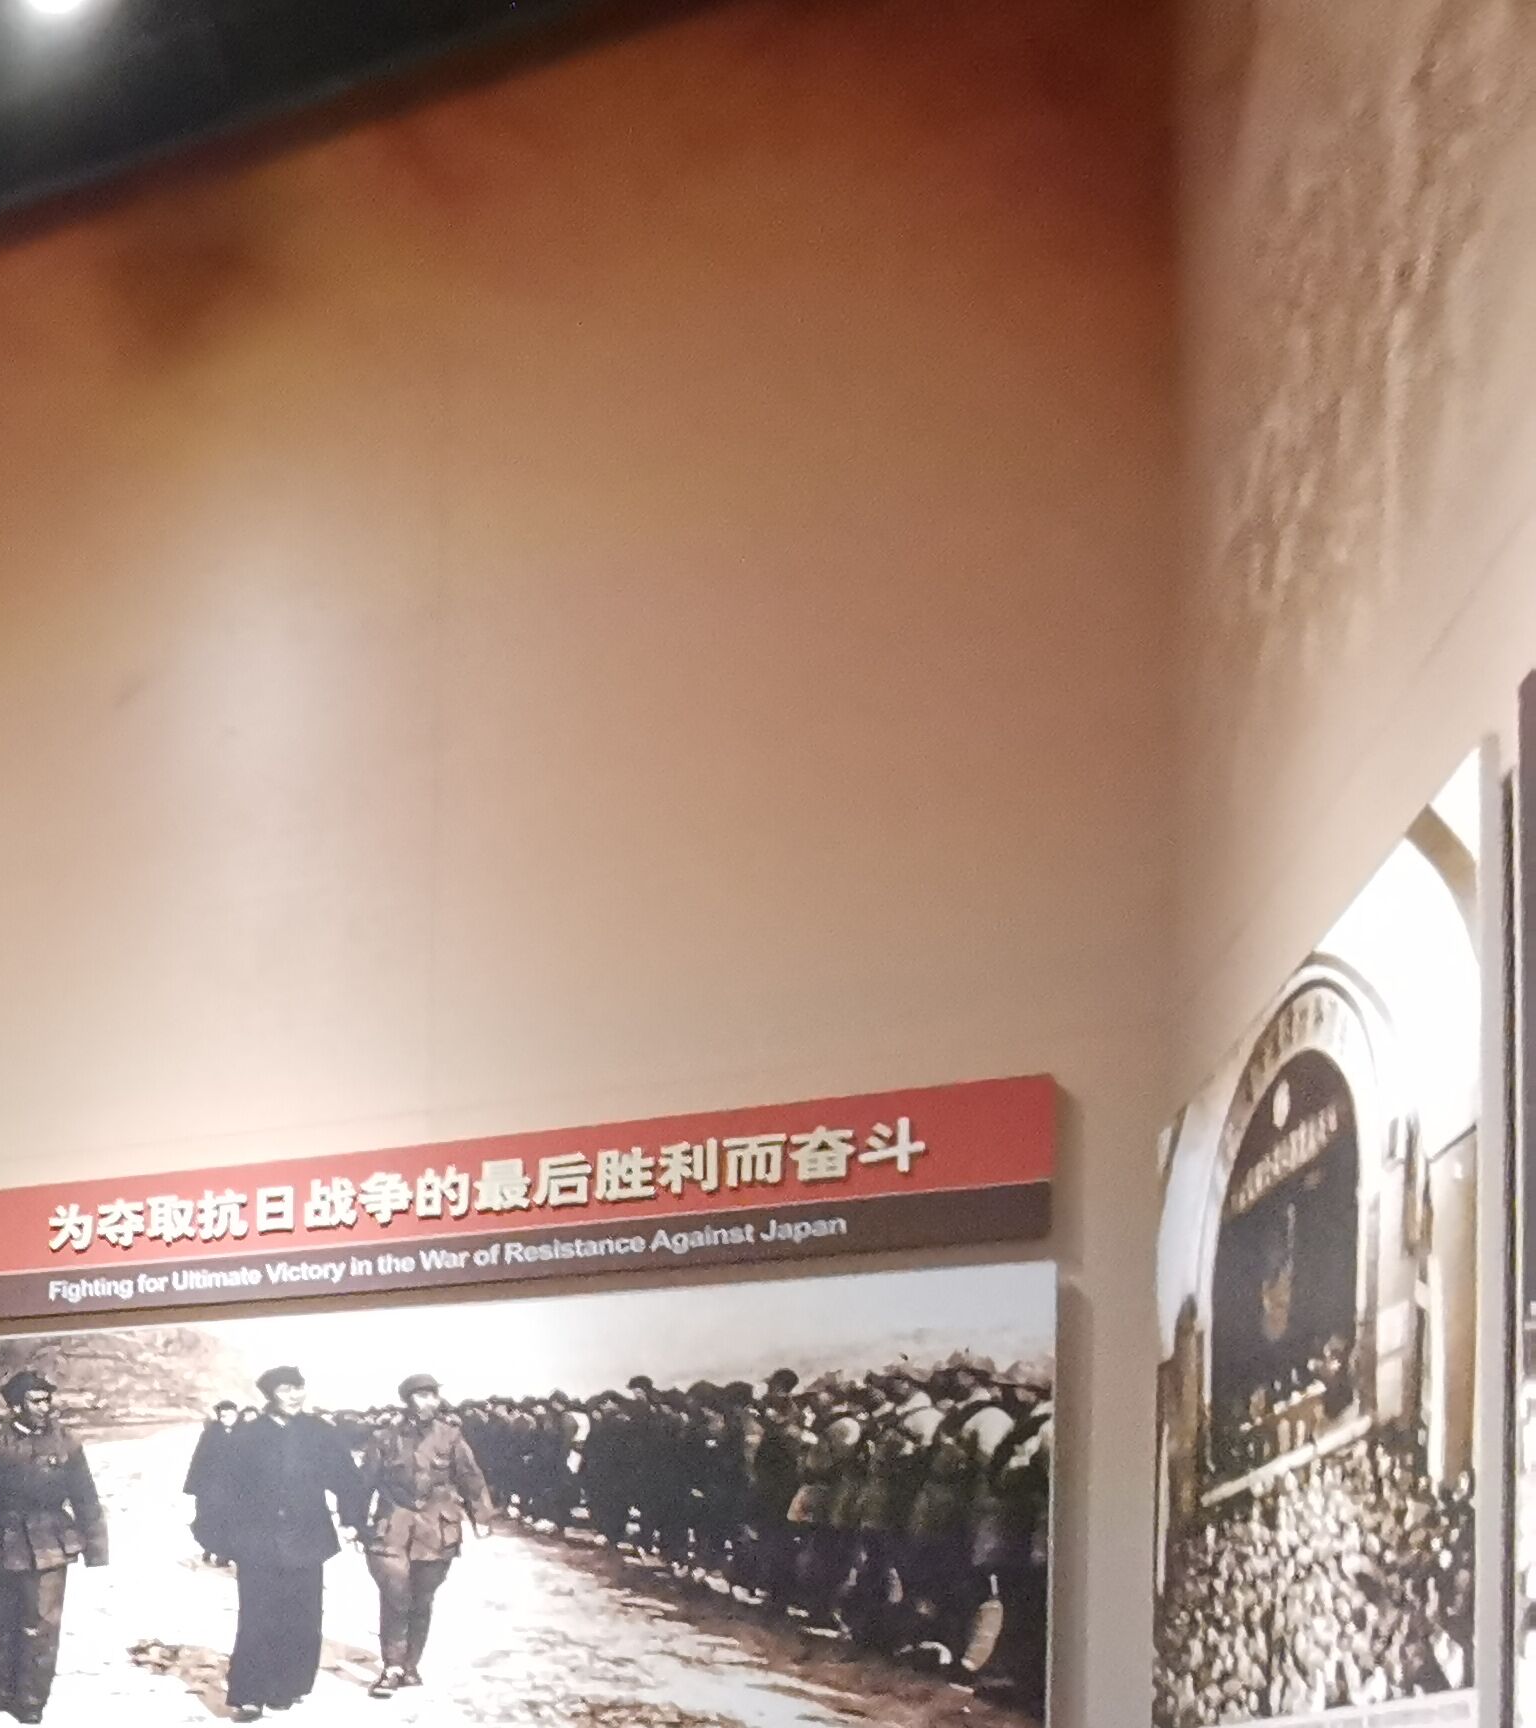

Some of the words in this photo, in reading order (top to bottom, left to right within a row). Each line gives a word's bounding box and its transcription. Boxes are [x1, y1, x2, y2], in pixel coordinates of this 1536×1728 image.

[48, 1115, 926, 1252] 为夺取抗日战争的最后胜利而奋斗
[48, 1278, 135, 1304] Fighting
[137, 1272, 169, 1294] for
[171, 1265, 262, 1292] Ultimate
[265, 1258, 347, 1284] Victory
[350, 1255, 373, 1277] in
[377, 1252, 416, 1273] the
[418, 1248, 470, 1271] War
[473, 1243, 502, 1266] of
[504, 1234, 648, 1264] Resistance
[649, 1223, 757, 1254] Against
[759, 1216, 848, 1243] Japan
